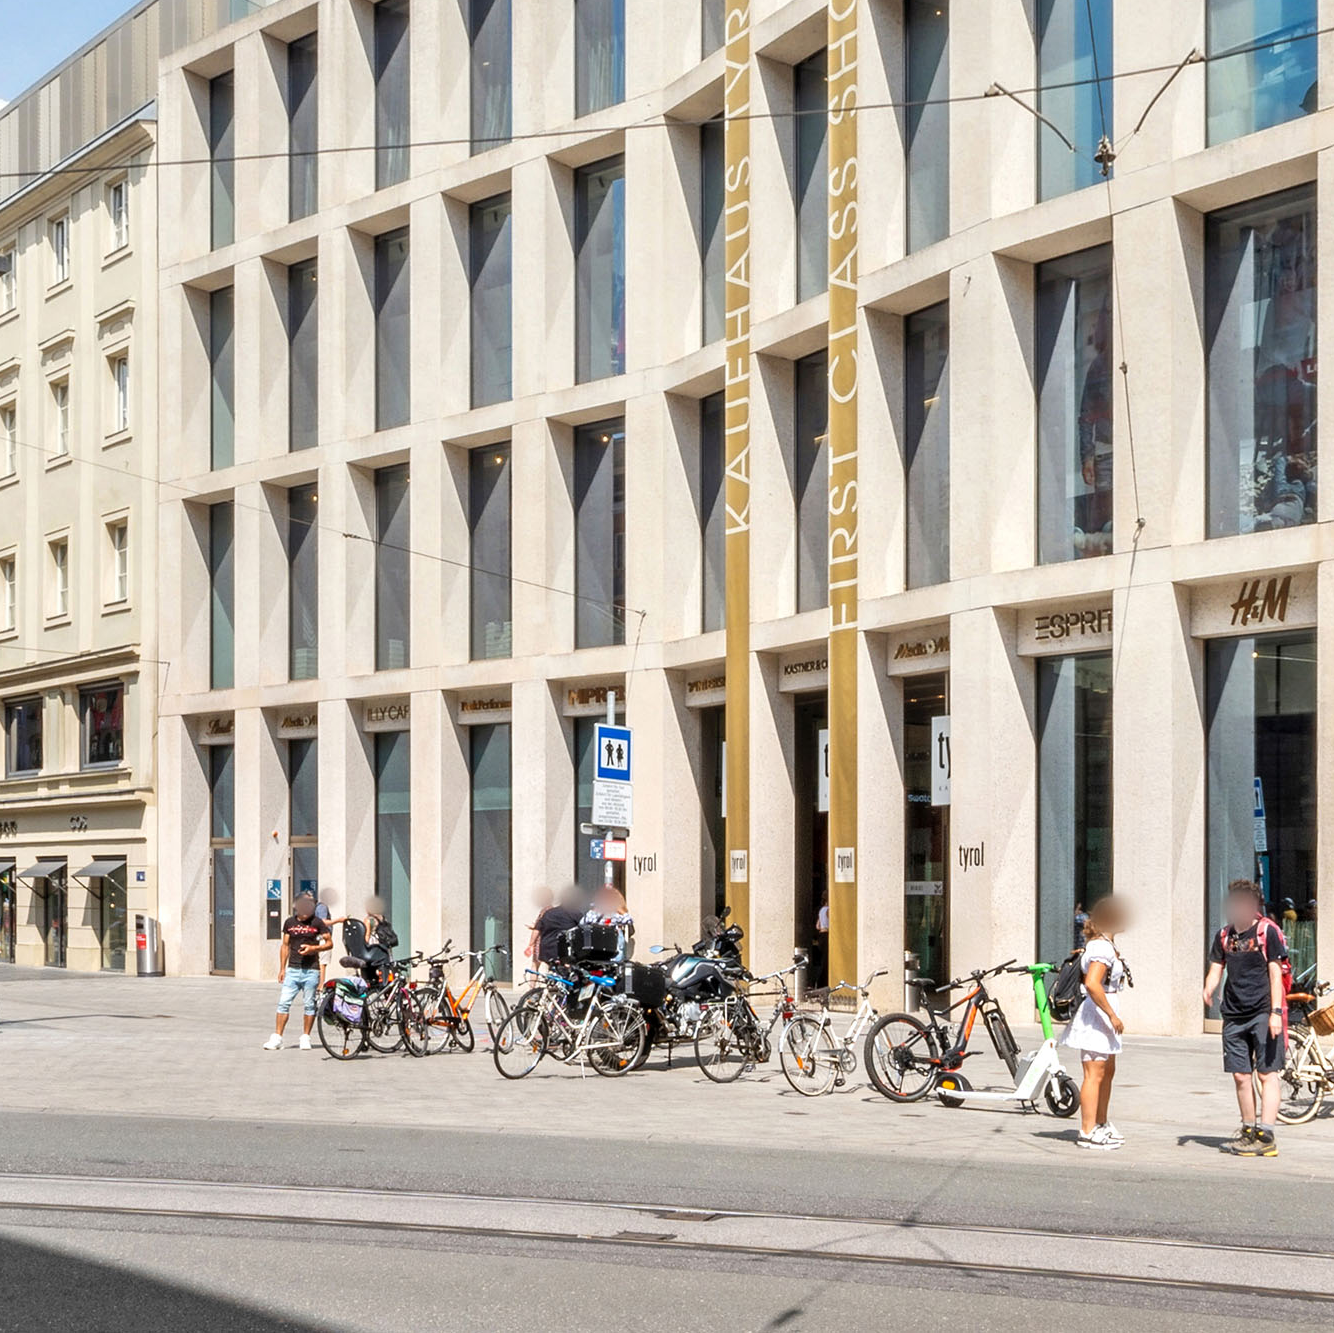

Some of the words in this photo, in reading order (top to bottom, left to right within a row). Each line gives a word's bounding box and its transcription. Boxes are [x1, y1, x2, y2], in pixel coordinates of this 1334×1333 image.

[827, 156, 858, 404] CLASS
[724, 155, 750, 535] KAUFHAUS
[828, 446, 858, 633] FIRST
[1230, 575, 1293, 627] H&M
[784, 659, 817, 676] KASTNER
[633, 852, 657, 876] tyrol
[837, 851, 853, 872] tyrol
[958, 841, 985, 873] tyrol
